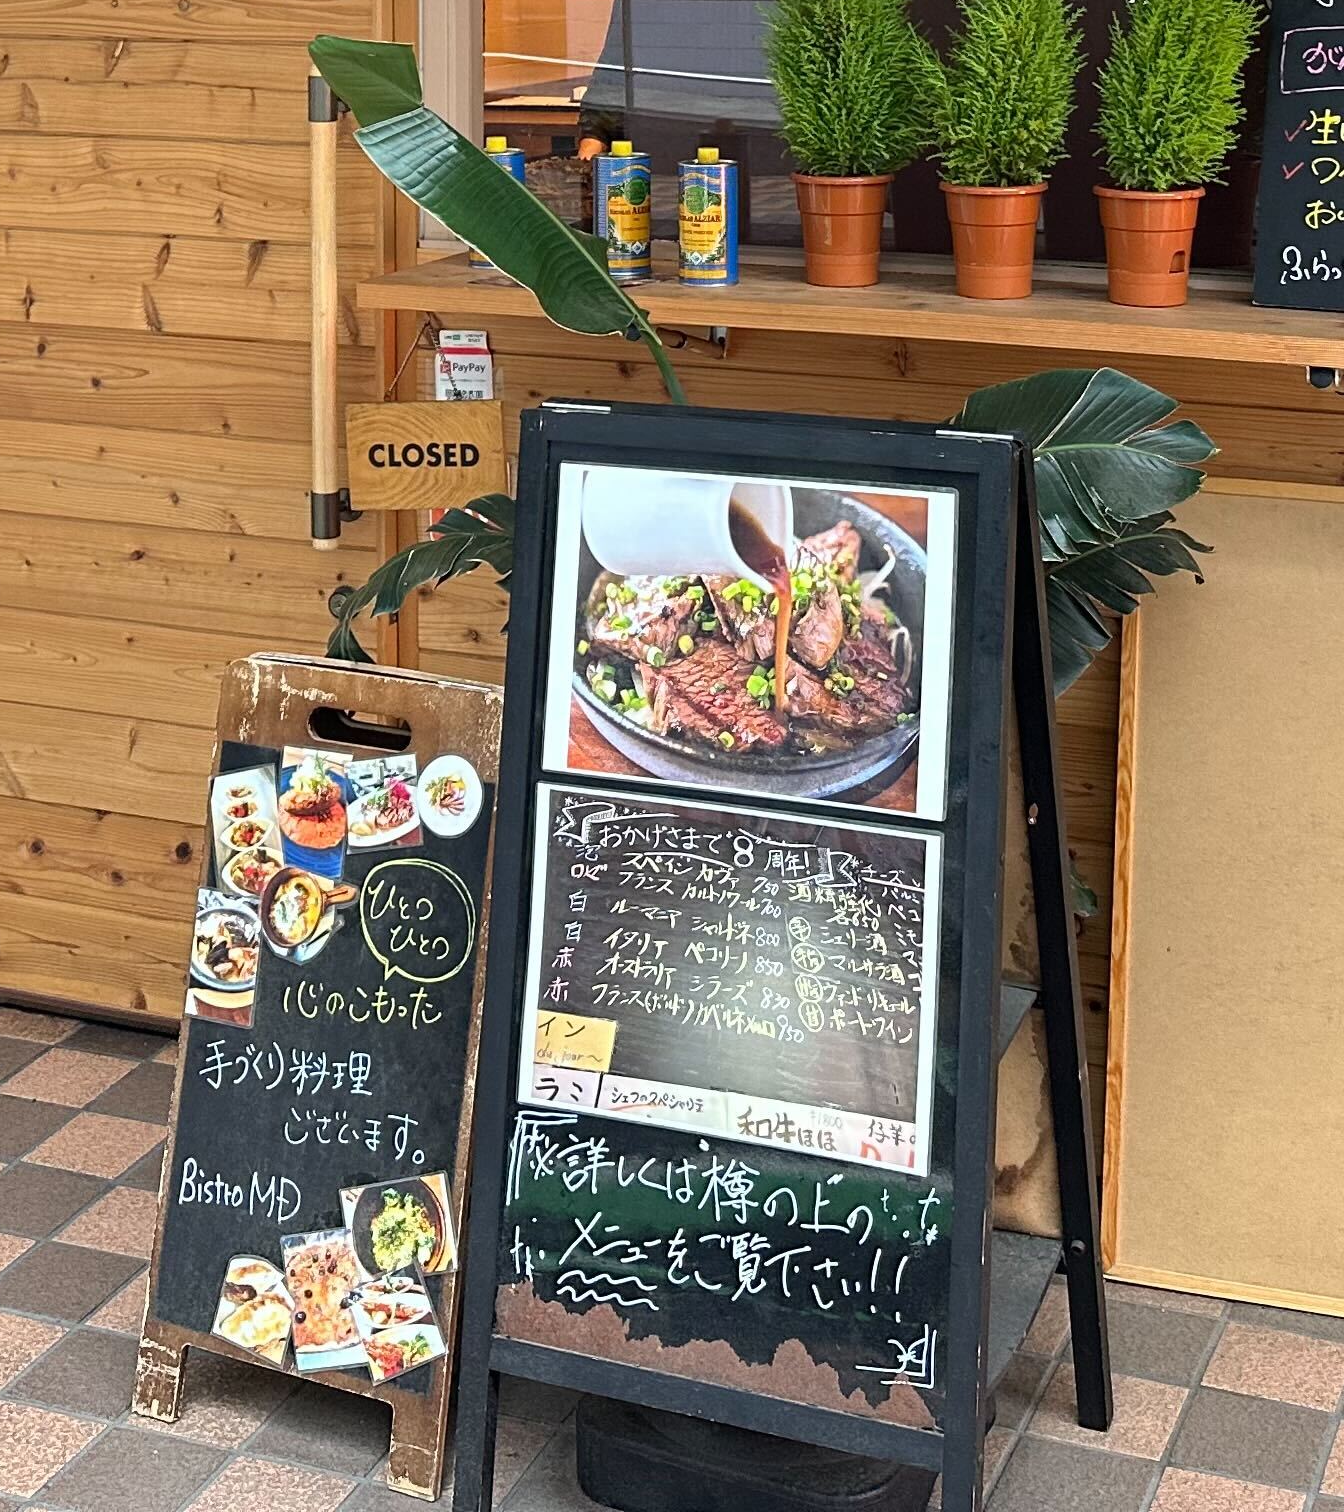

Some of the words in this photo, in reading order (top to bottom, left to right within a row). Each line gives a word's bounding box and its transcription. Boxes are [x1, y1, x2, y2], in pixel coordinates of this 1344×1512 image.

[452, 362, 486, 374] PayPay
[368, 442, 480, 468] CLOSED
[367, 879, 434, 921] ひとつ
[568, 889, 587, 912] 白
[755, 927, 780, 947] 800
[388, 925, 449, 961] ひとつ
[564, 920, 583, 942] 白
[603, 928, 669, 960] イタリア
[754, 956, 784, 977] 850
[552, 946, 575, 969] 赤
[688, 975, 754, 1006] シラーズ
[283, 980, 442, 1030] 心のこもった
[543, 977, 569, 1002] 赤
[776, 1014, 805, 1043] 950
[830, 1008, 913, 1044] ポートワイン
[198, 1039, 373, 1096] 手づくり料理
[284, 1107, 426, 1165] ございます。
[736, 1105, 837, 1152] 和牛ほほ
[178, 1157, 243, 1209] Bistro
[249, 1172, 303, 1223] MD
